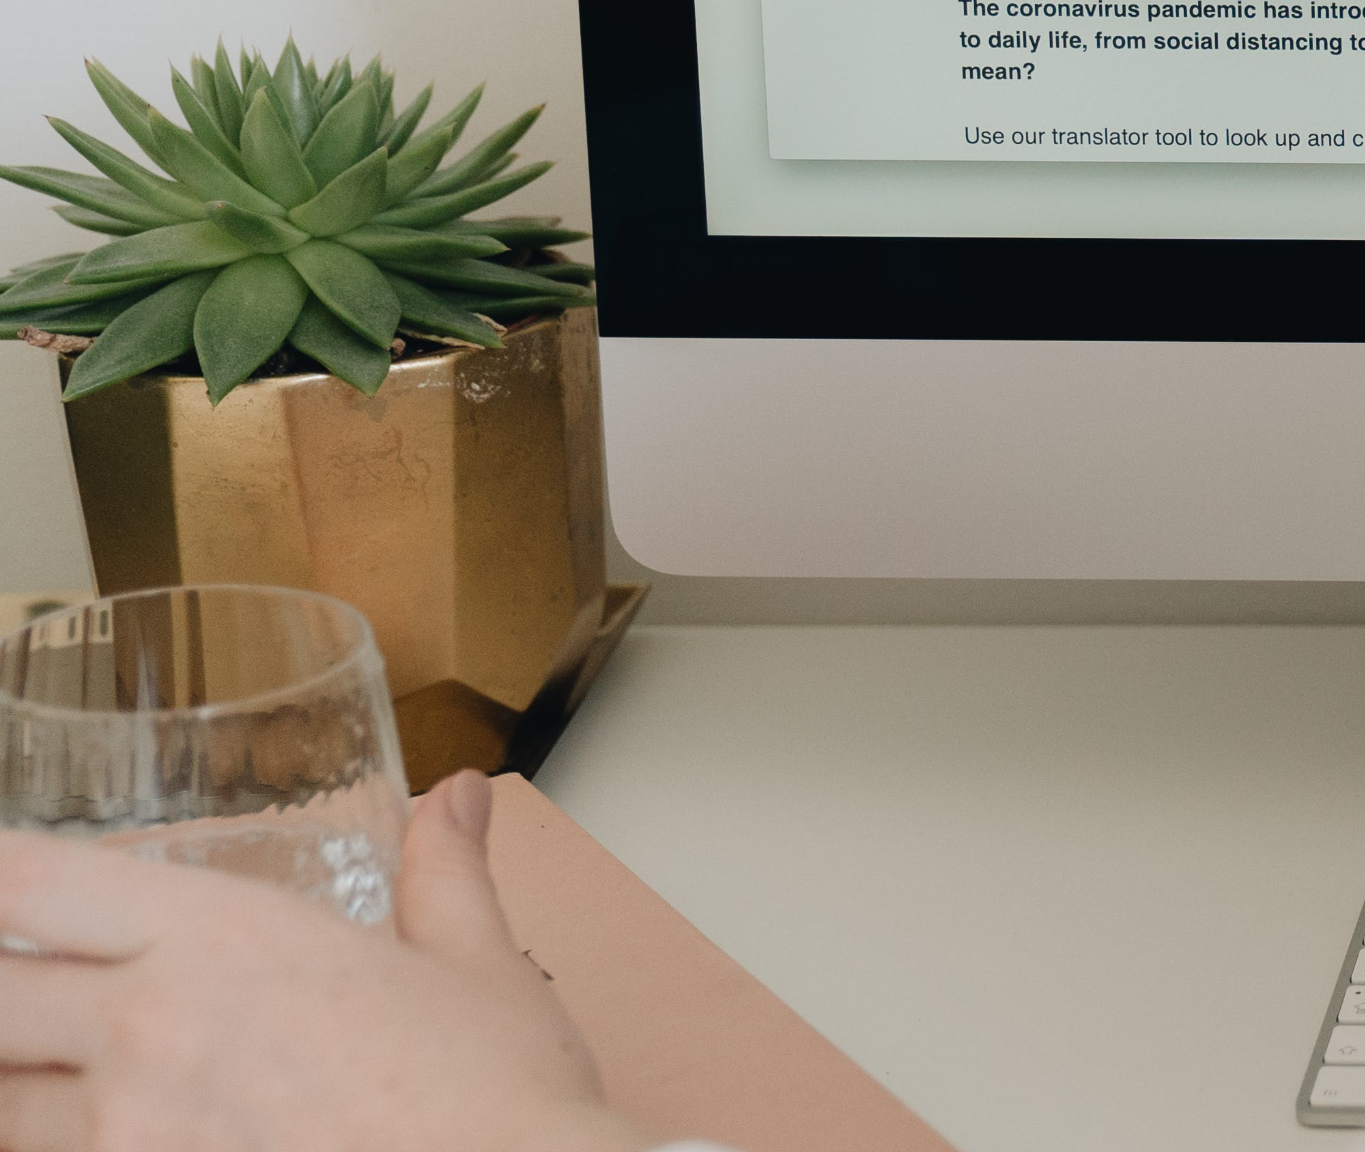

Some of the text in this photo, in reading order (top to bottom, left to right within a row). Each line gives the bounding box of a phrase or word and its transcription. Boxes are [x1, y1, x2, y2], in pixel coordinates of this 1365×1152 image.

[958, 0, 999, 16] The
[1007, 0, 1139, 17] coronavirus
[1148, 1, 1256, 22] pandemic
[1264, 1, 1302, 18] has
[960, 32, 980, 48] to
[989, 31, 1040, 53] daily
[1049, 31, 1087, 52] life,
[1095, 32, 1145, 49] from
[1154, 32, 1218, 49] social
[1227, 33, 1342, 55] distancing
[962, 63, 1034, 79] mean?
[965, 127, 1004, 144] Use
[1012, 131, 1045, 144] our
[1052, 128, 1148, 145] translator
[1155, 129, 1192, 145] tool
[1200, 130, 1218, 145] to
[1226, 129, 1267, 146] look
[1276, 134, 1300, 151] up
[1308, 130, 1344, 146] and
